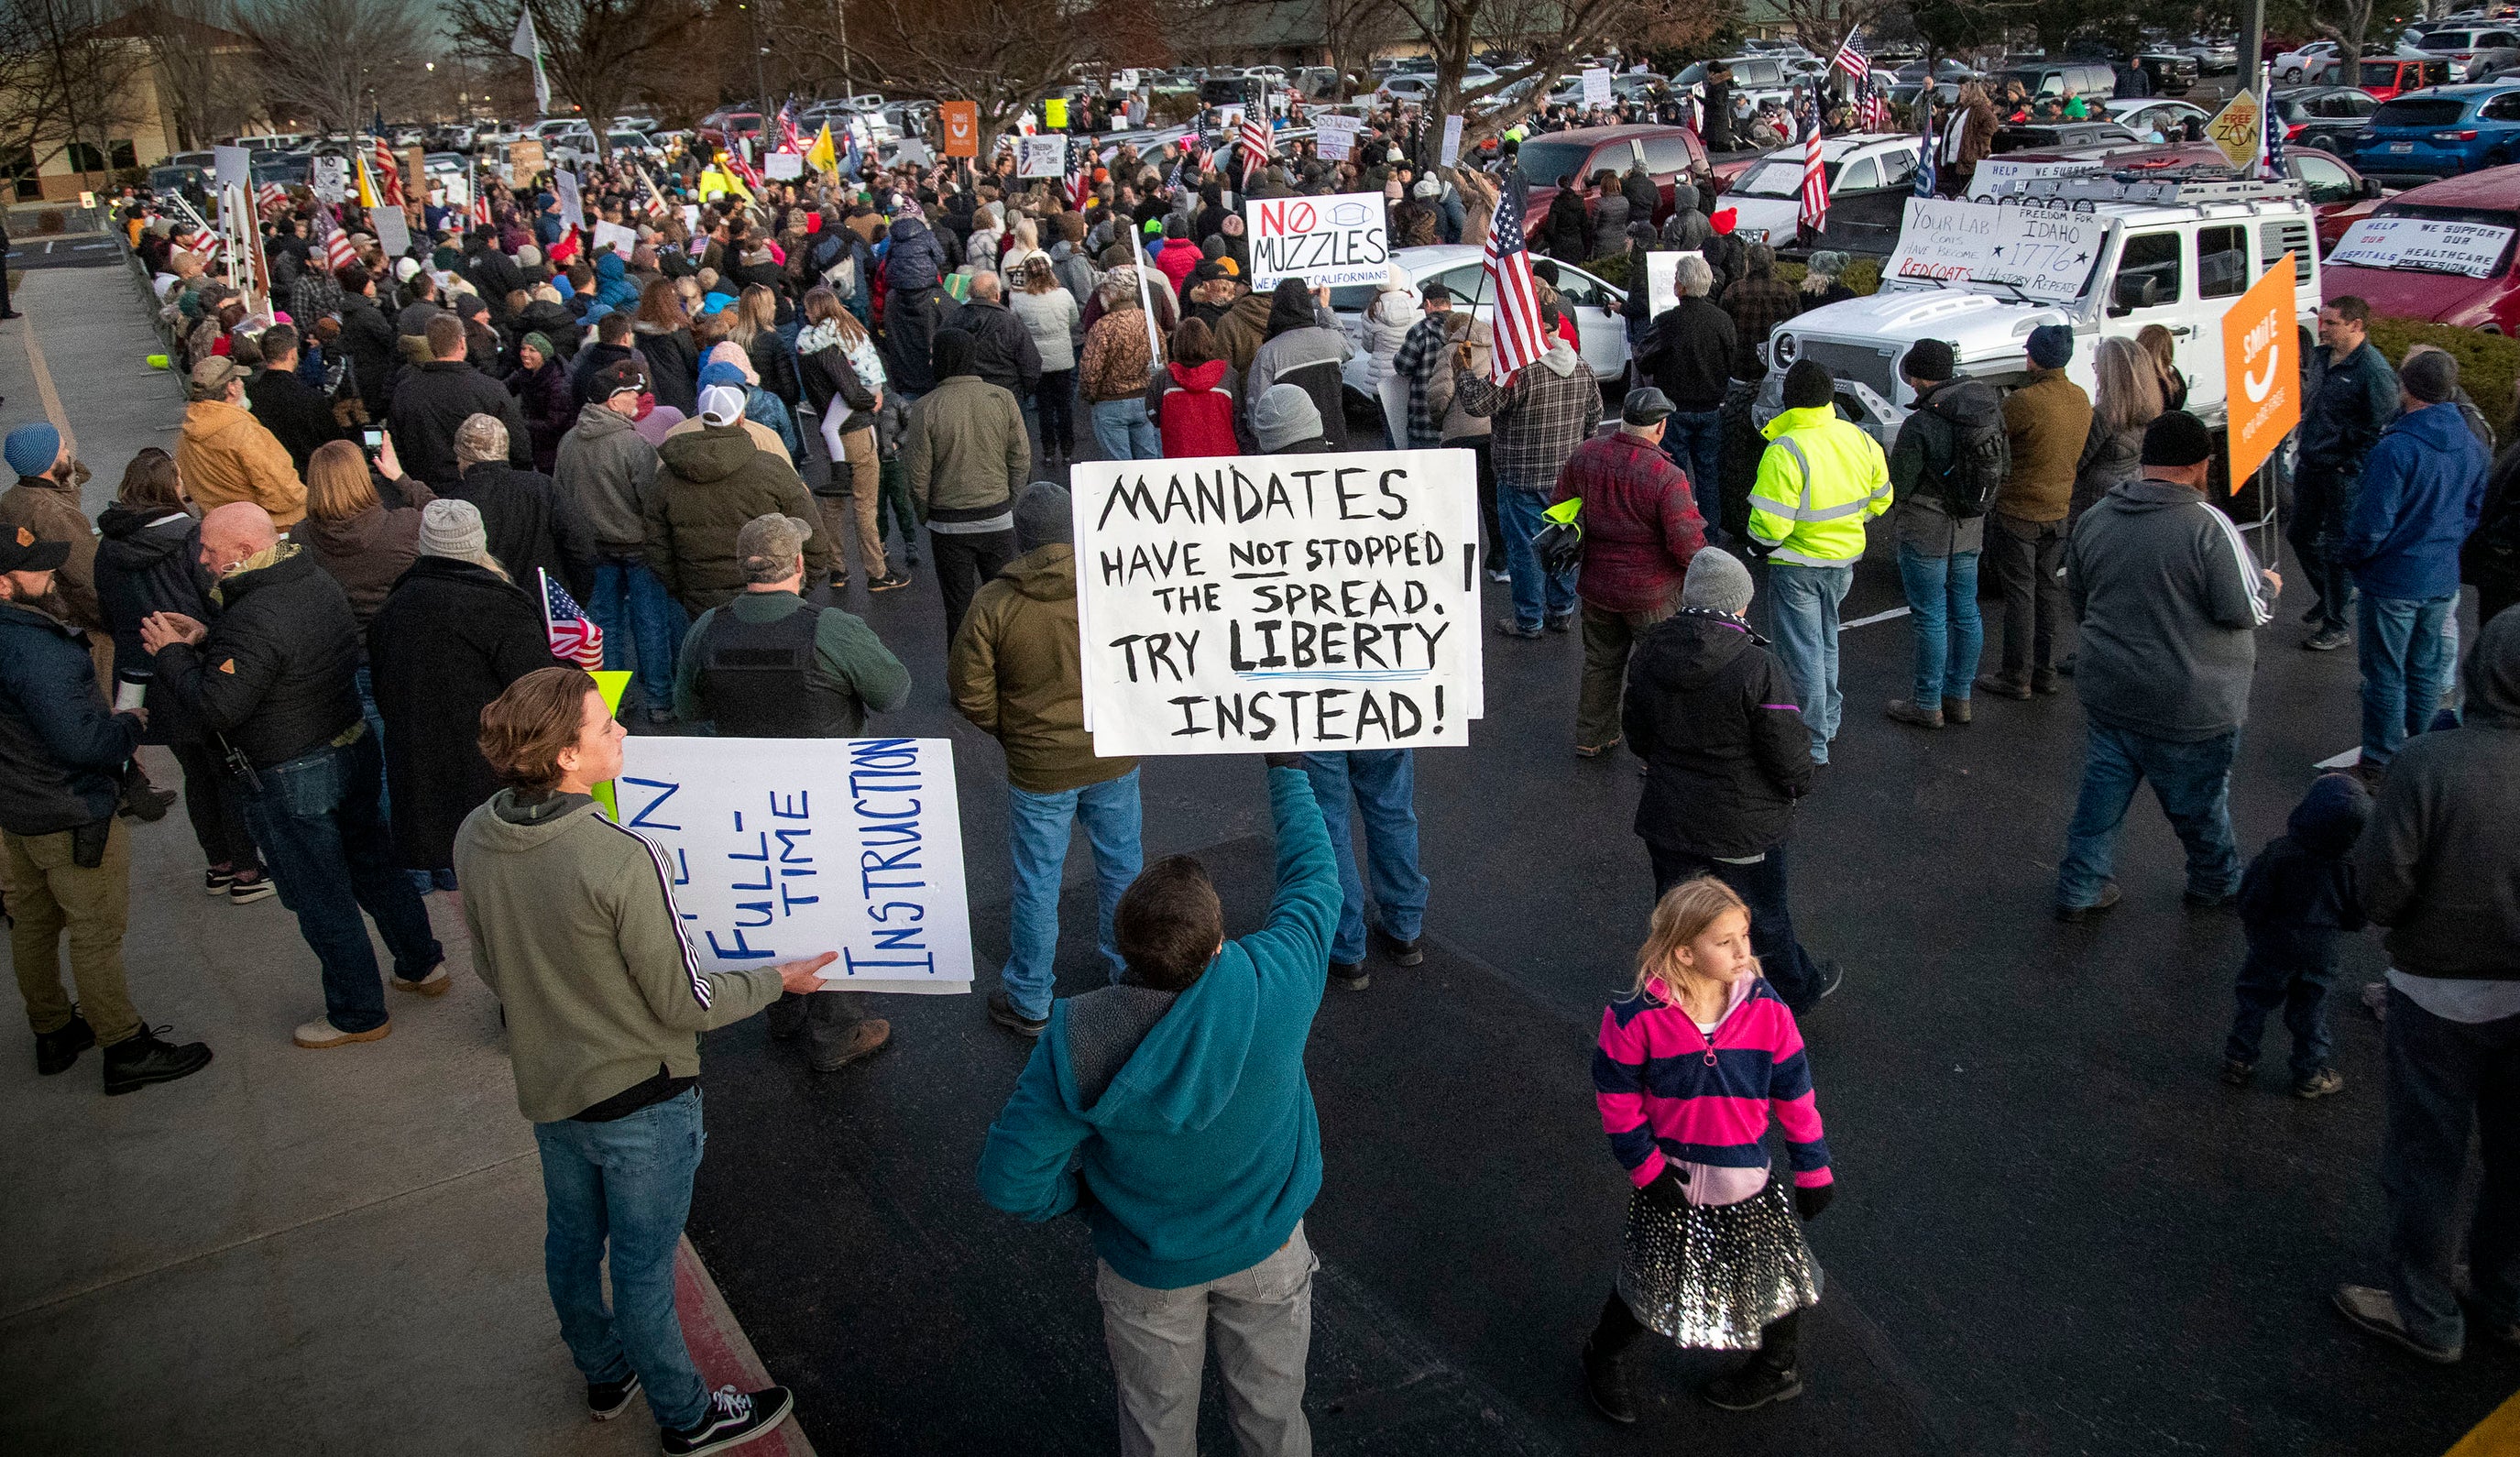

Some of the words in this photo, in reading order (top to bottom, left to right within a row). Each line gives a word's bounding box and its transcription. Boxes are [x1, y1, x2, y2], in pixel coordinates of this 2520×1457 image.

[2223, 115, 2252, 124] FREE
[1992, 166, 2018, 176] HELP
[2034, 167, 2047, 177] WE
[1261, 201, 1316, 236] NO
[1912, 202, 1951, 230] YOUR
[1959, 213, 1989, 235] LAB
[2019, 209, 2067, 221] FREEDOM
[2075, 214, 2093, 224] FOR
[2022, 221, 2080, 244] IDAHO
[2361, 236, 2385, 244] OUR
[2420, 224, 2437, 233] WE
[2443, 225, 2505, 240] SUPPORT
[2443, 236, 2471, 245] OUR
[1253, 228, 1386, 273] MUZZLES
[1903, 244, 1929, 256] HAVE
[1937, 246, 1979, 259] BECOME
[2008, 243, 2071, 271] 1776
[2405, 247, 2493, 266] HEALTHCARE
[1254, 278, 1269, 290] WE
[1314, 270, 1388, 285] CALIFORNIANS
[1898, 257, 1974, 281] REDCOATS
[1986, 267, 2031, 289] HISTORY
[2032, 274, 2077, 292] REPEATS
[1097, 465, 1408, 531] MANDATES
[1100, 541, 1206, 586] HAVE
[1230, 540, 1293, 569] NOT
[1306, 530, 1444, 572] STOPPED
[1152, 582, 1222, 615] THE
[1251, 579, 1445, 618] SPREAD.
[1109, 630, 1200, 684] TRY
[1230, 619, 1450, 671] LIBERTY
[1167, 685, 1444, 745] INSTEAD!
[770, 790, 819, 916] TIME
[844, 739, 935, 975] INSTRUCTION
